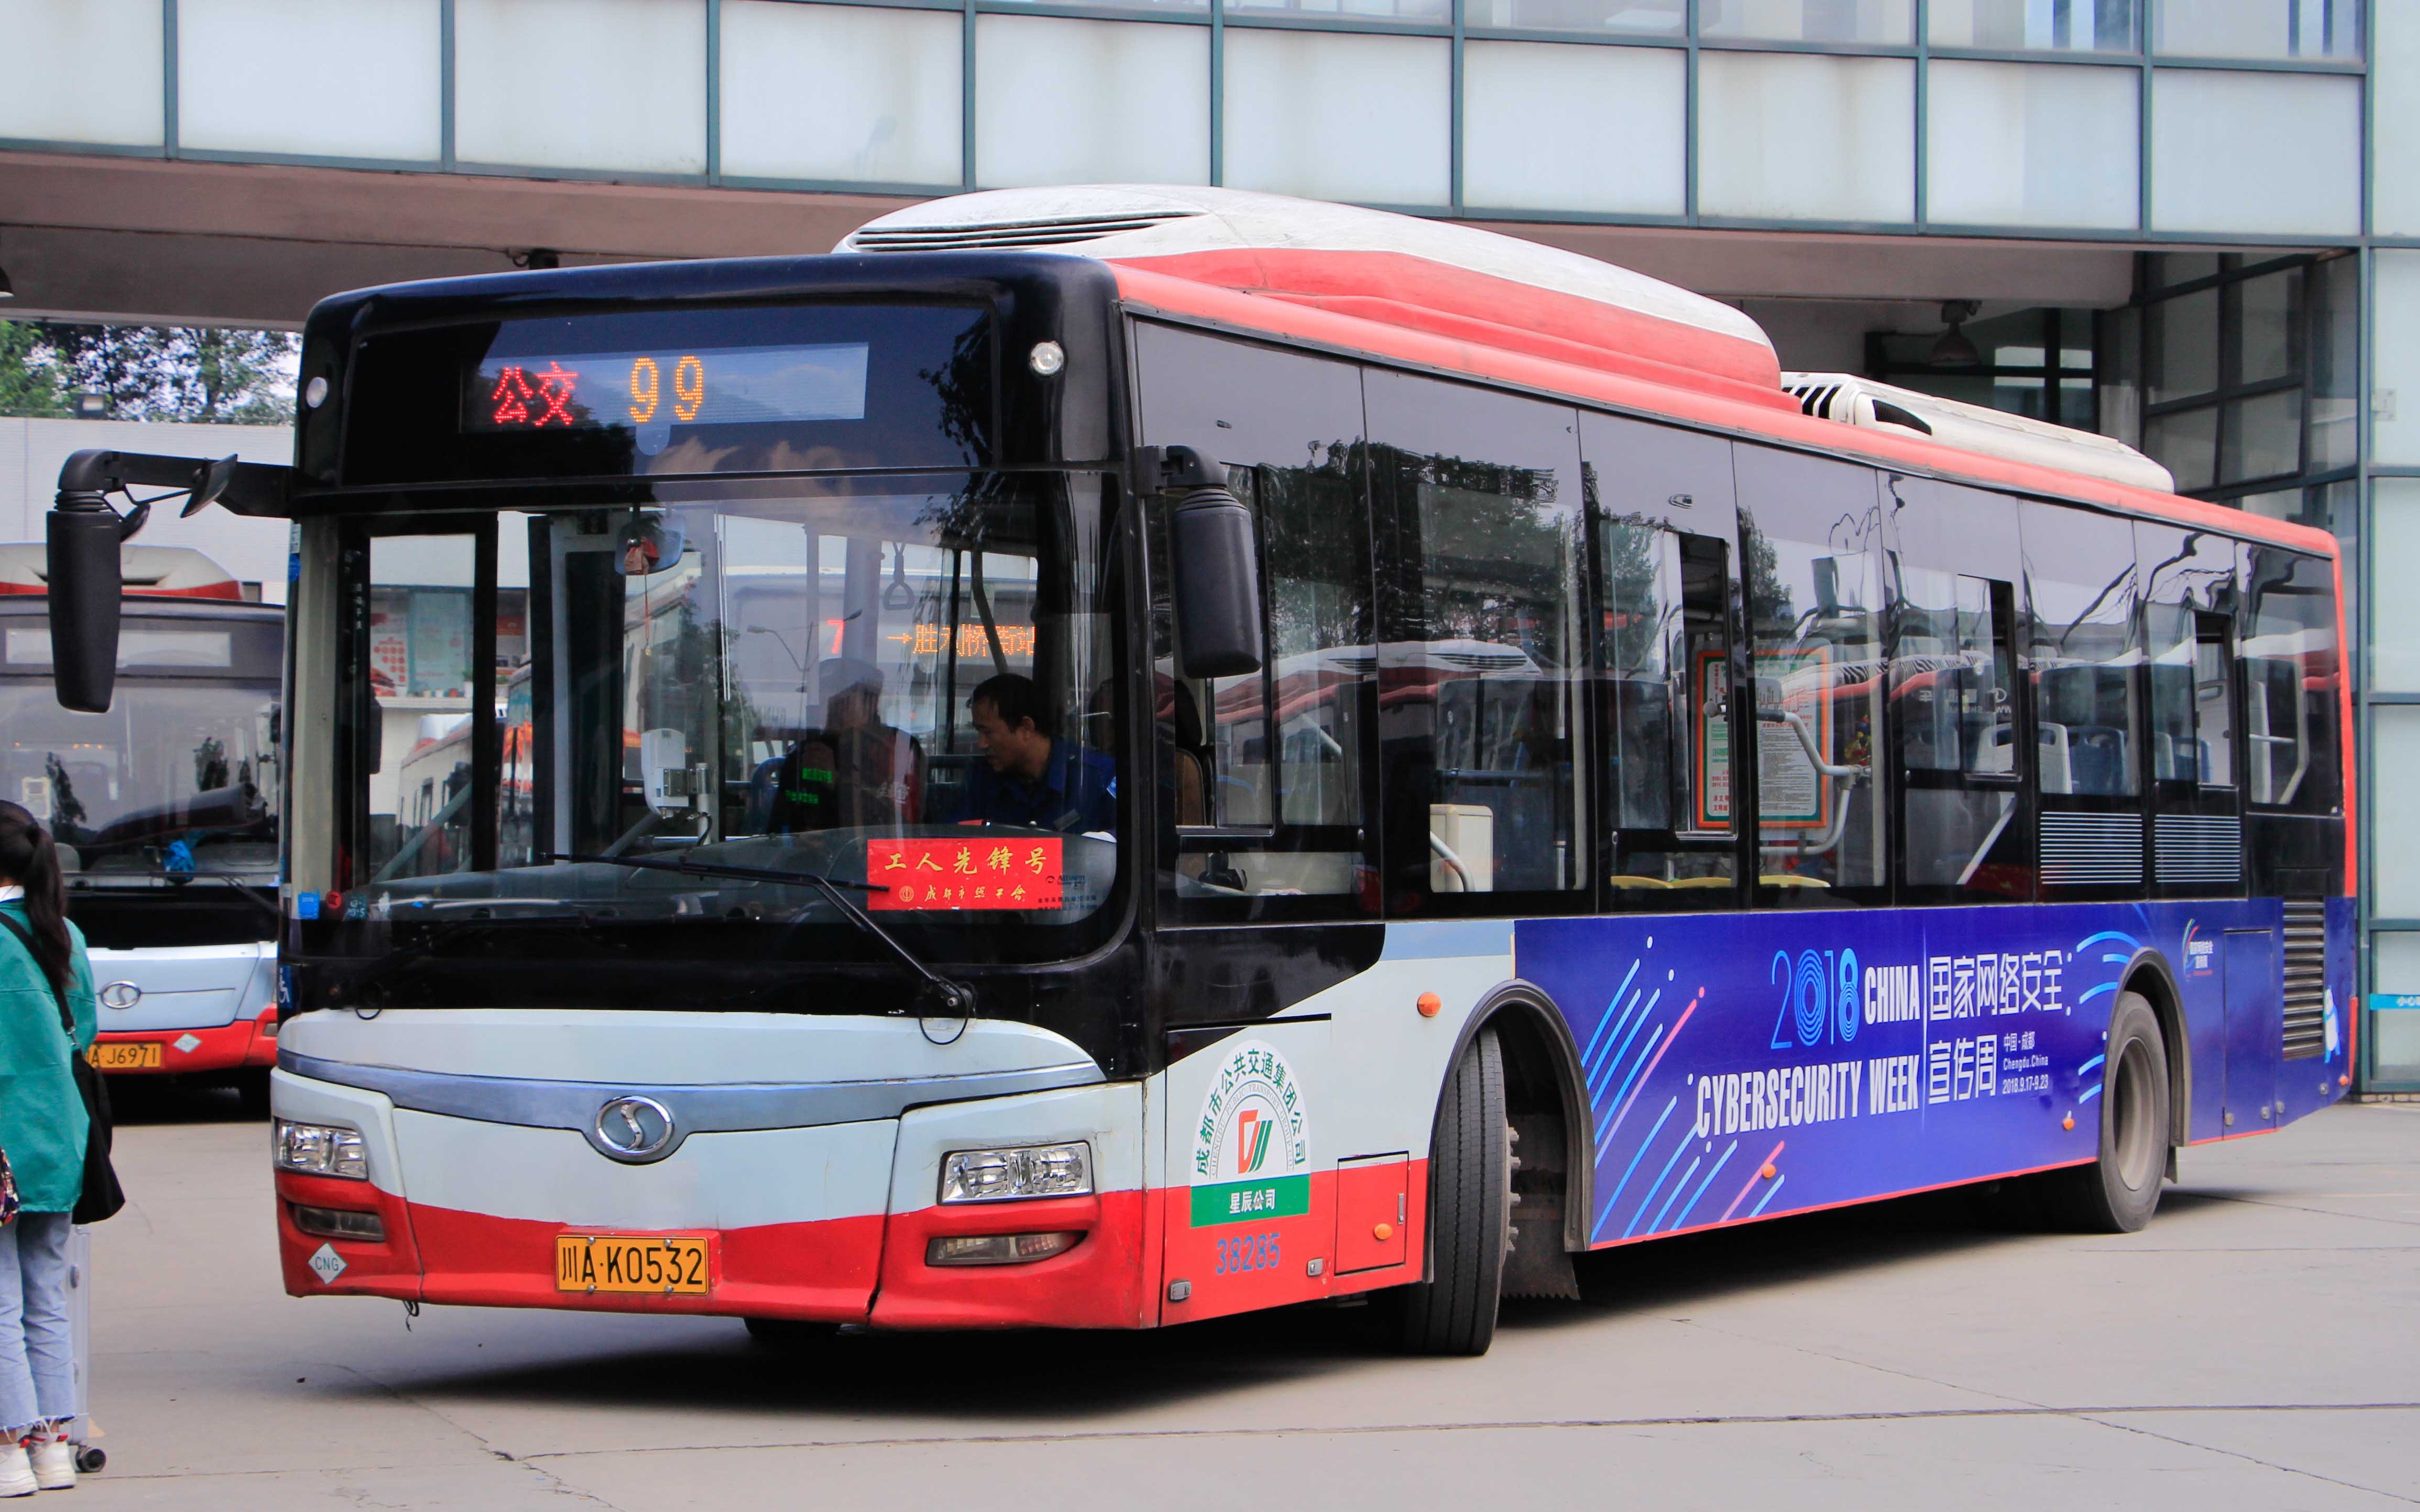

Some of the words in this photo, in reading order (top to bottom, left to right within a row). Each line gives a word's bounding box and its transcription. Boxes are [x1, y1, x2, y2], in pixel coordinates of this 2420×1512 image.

[492, 360, 579, 426] 公交
[629, 355, 705, 423] 99
[885, 846, 1047, 875] 工人先锋号
[1770, 948, 1859, 1050] 2018
[1864, 964, 1921, 1025] CHINA
[1929, 949, 2063, 1021] 国家网络安全
[86, 1047, 156, 1064] A·J6971
[1928, 1034, 1997, 1105] 宣传周
[1196, 1048, 1306, 1176] 成都市公共交通集团公司
[1697, 1061, 1863, 1138] CYBERSECURITY
[1869, 1054, 1920, 1115] WEEK
[1211, 1120, 1225, 1176] CHENGDU
[1229, 1188, 1276, 1214] 星辰公司
[314, 1256, 339, 1272] CNG
[1216, 1233, 1280, 1275] 38285
